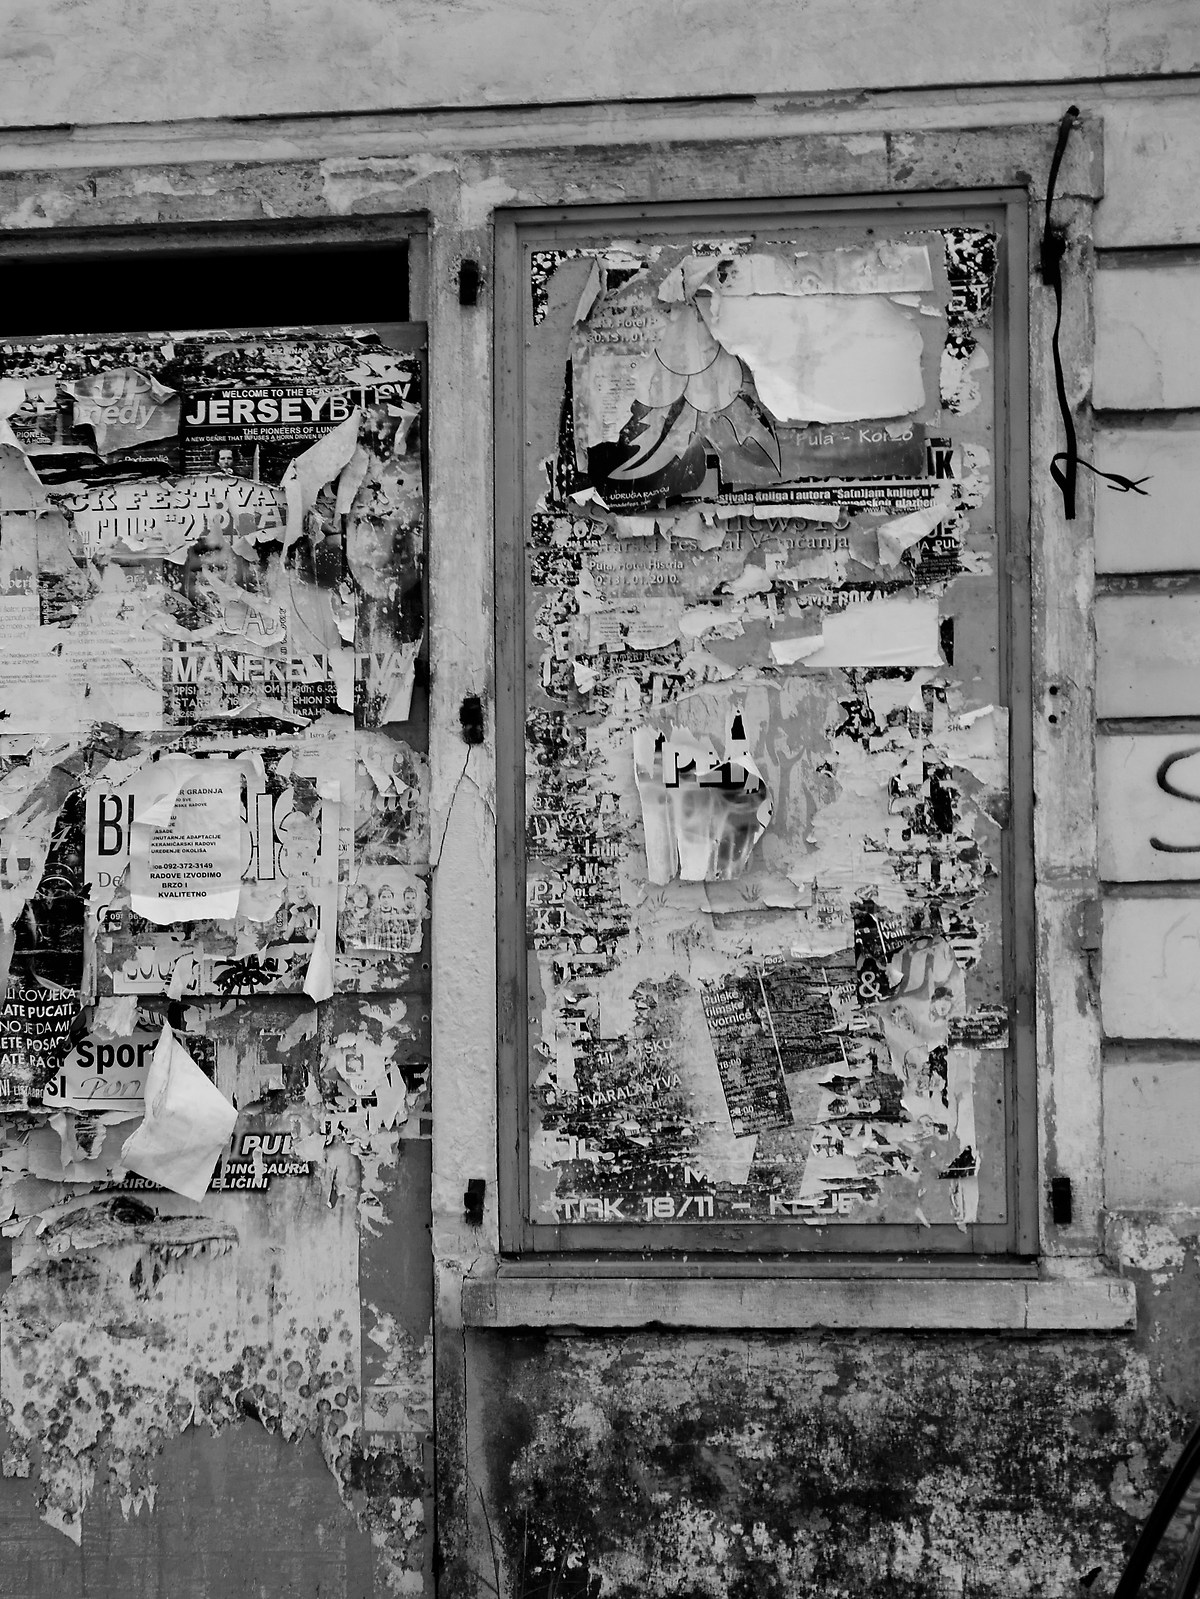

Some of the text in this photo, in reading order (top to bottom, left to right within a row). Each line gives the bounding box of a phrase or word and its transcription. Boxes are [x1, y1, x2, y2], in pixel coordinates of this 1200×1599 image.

[221, 389, 269, 399] WELCOME
[271, 389, 284, 398] TO
[286, 388, 304, 397] THE
[242, 427, 259, 435] THE
[260, 426, 301, 435] PIONEERS
[302, 426, 313, 434] OF
[796, 490, 831, 500] autora
[886, 487, 921, 500] knjige
[172, 653, 401, 683] MANEKENTVA
[187, 788, 224, 796] GRADNJA
[18, 986, 76, 1002] ČOVJEKA
[0, 1003, 76, 1018] ATE PUCATI.
[705, 1001, 745, 1018] filmske
[708, 1009, 752, 1029] tvornice
[36, 1021, 52, 1035] DA
[29, 1052, 65, 1069] RAČU
[209, 1175, 268, 1190] ELIČINI
